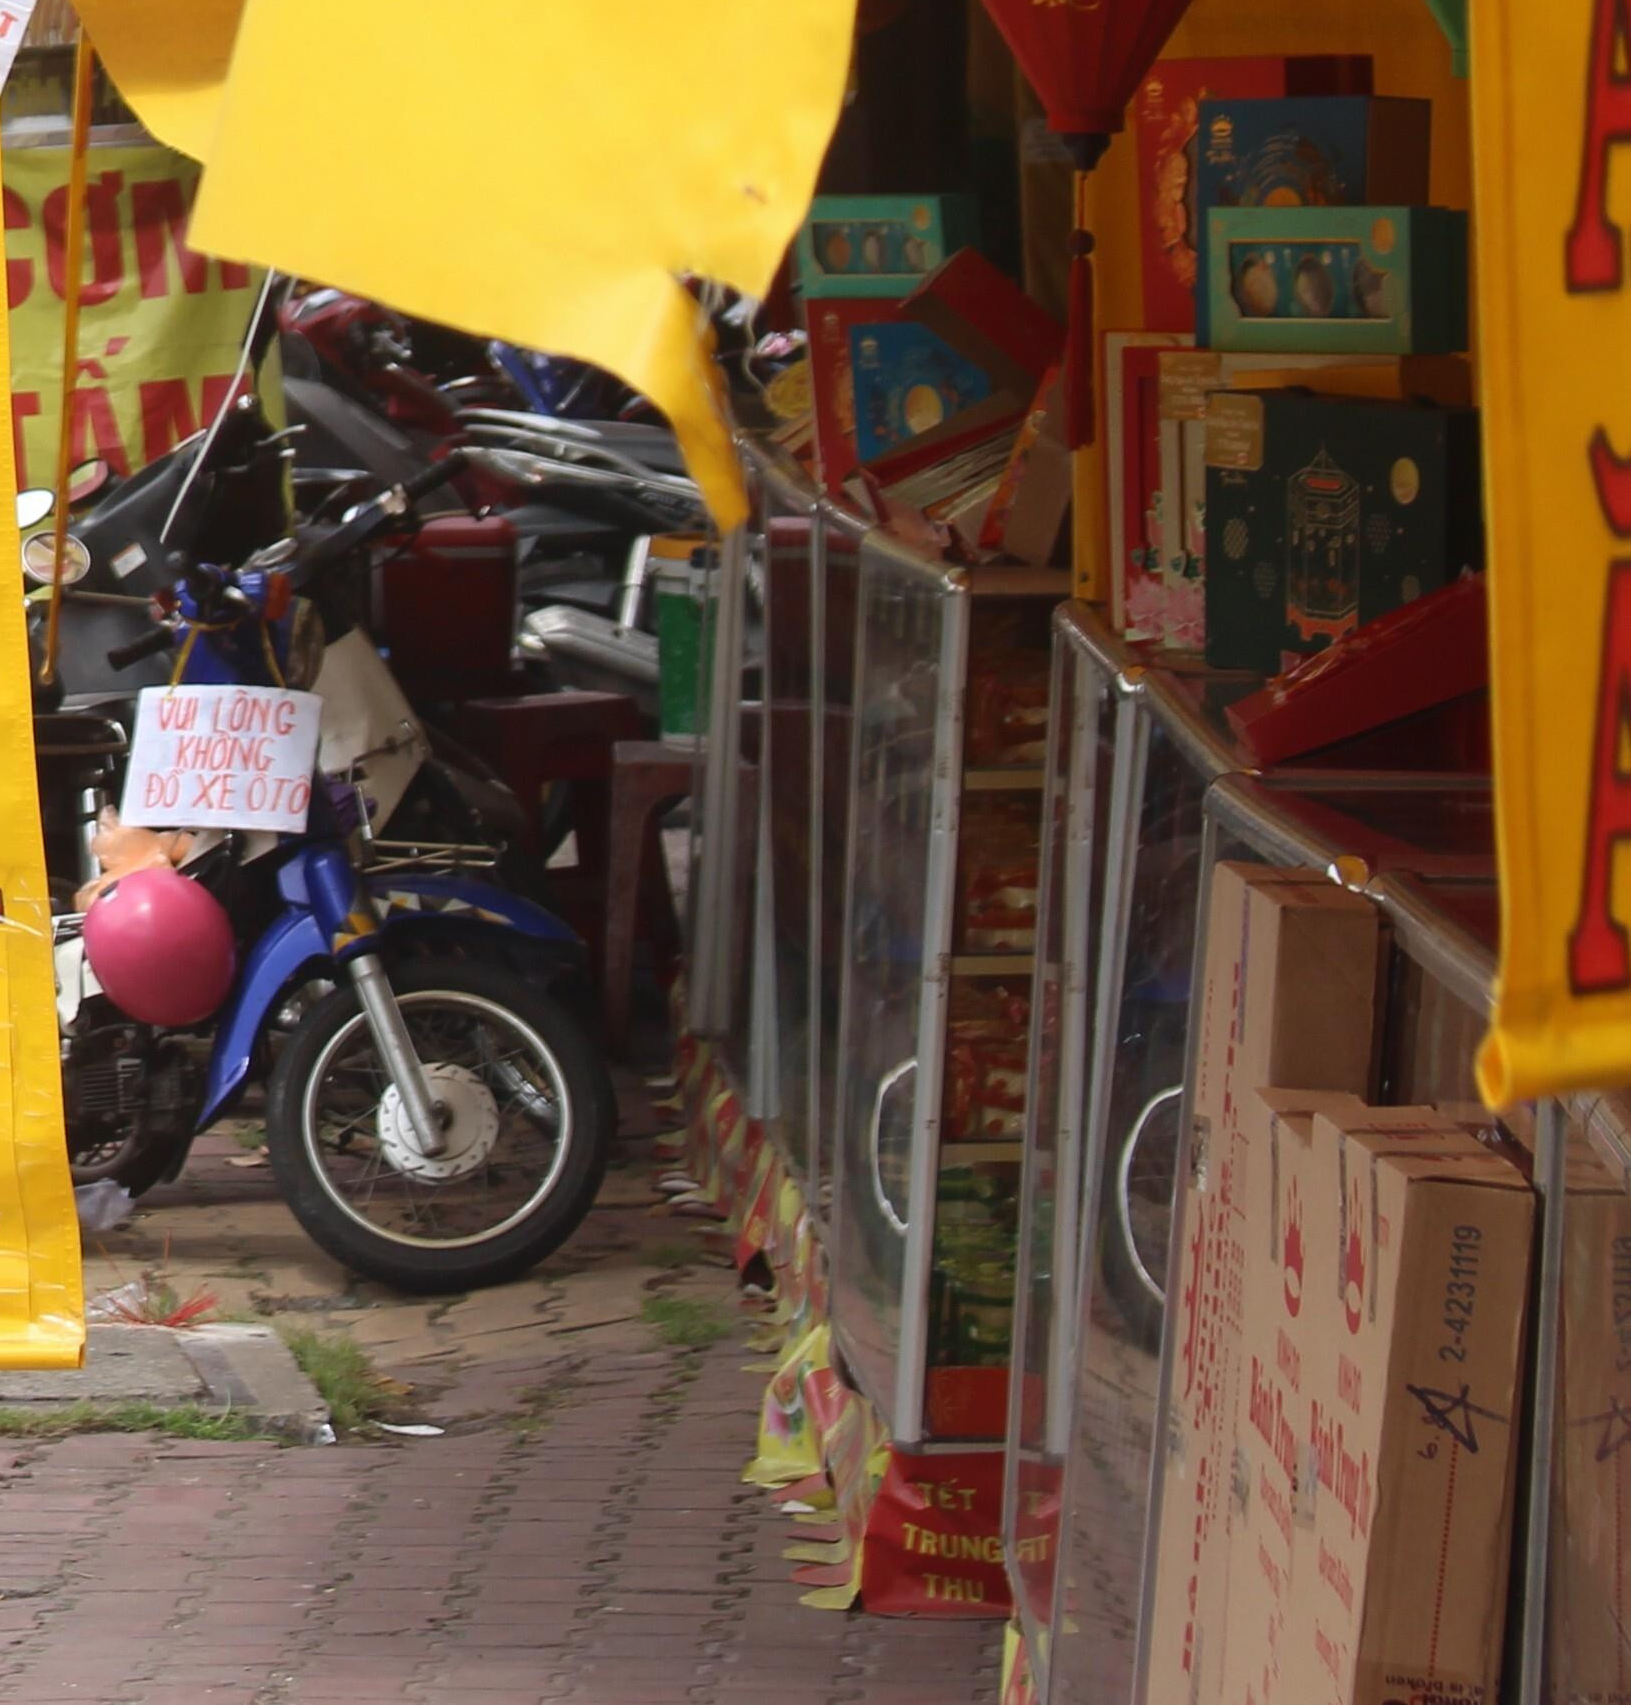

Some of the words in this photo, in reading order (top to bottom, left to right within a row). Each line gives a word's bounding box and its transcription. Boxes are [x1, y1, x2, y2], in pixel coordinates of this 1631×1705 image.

[158, 696, 200, 731] VUI
[192, 773, 238, 812] XE
[917, 1478, 978, 1511] TẾT
[902, 1522, 1006, 1564] TRUNG
[922, 1573, 985, 1603] THU
